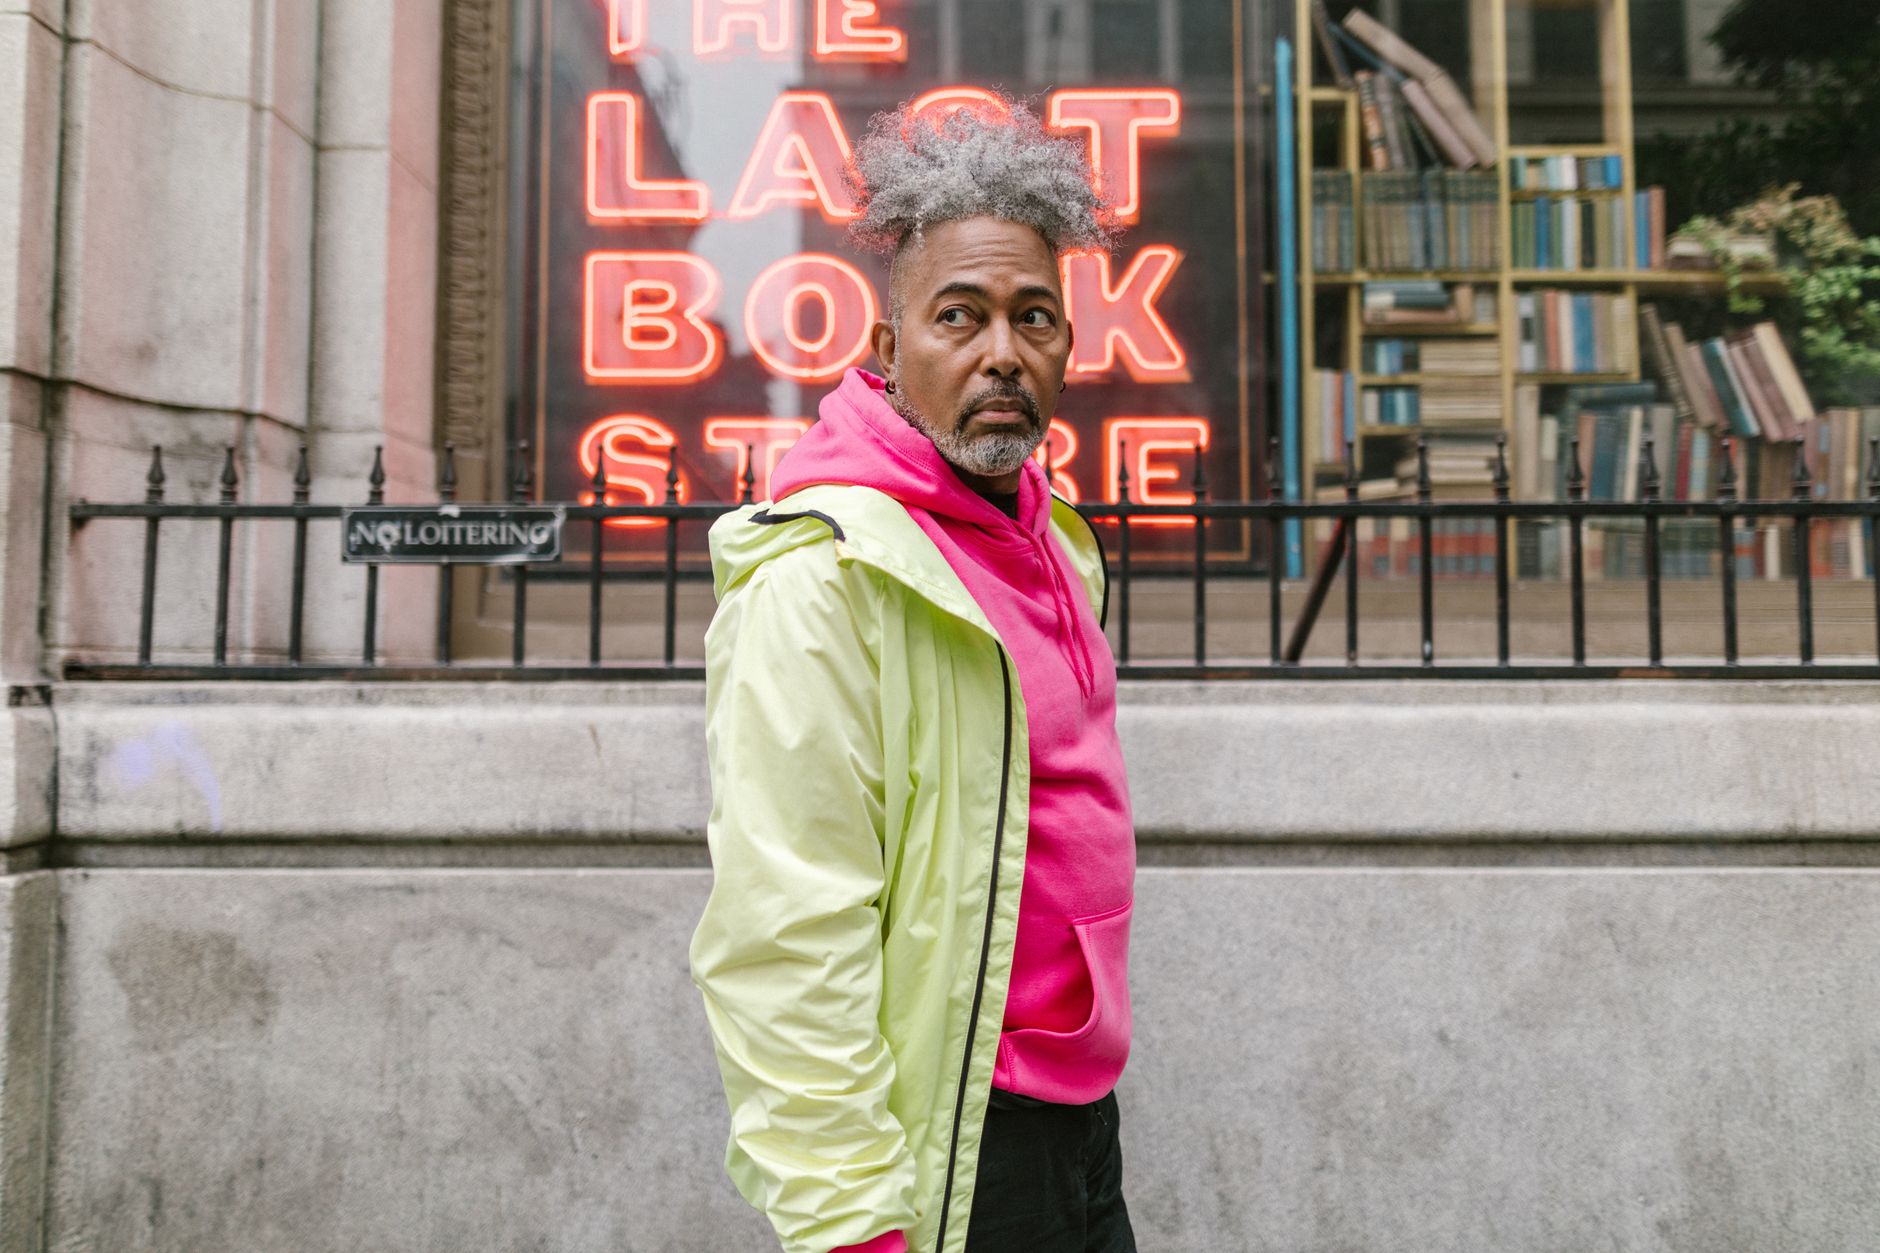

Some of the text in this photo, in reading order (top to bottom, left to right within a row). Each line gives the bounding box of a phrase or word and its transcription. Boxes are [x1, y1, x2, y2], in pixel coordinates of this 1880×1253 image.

[585, 90, 1180, 225] LAT
[582, 249, 1191, 385] BOK
[356, 520, 549, 546] NO LOITERING
